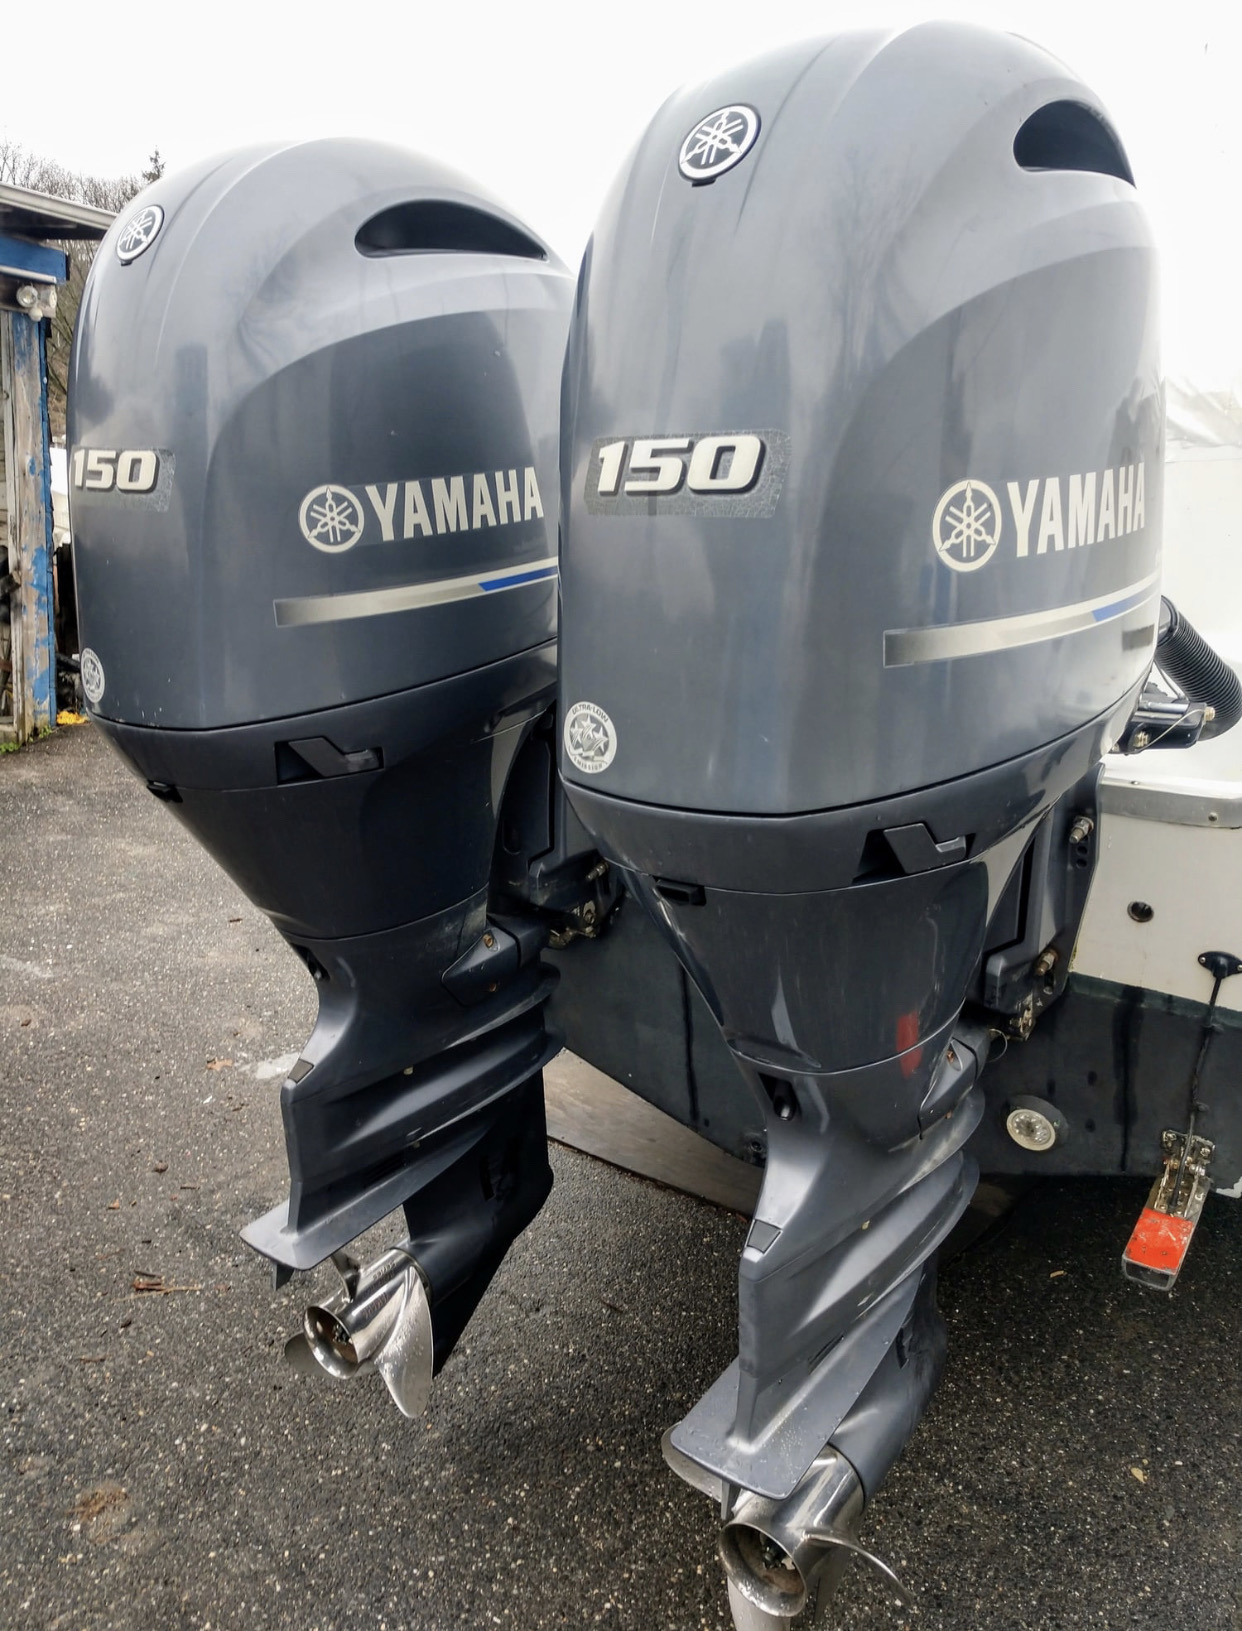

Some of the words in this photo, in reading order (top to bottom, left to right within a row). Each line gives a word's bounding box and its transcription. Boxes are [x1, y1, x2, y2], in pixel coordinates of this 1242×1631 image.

[74, 449, 159, 494] 150
[598, 435, 765, 494] 150
[365, 466, 544, 542] YAMAHA
[1007, 462, 1145, 558] YAMAHA
